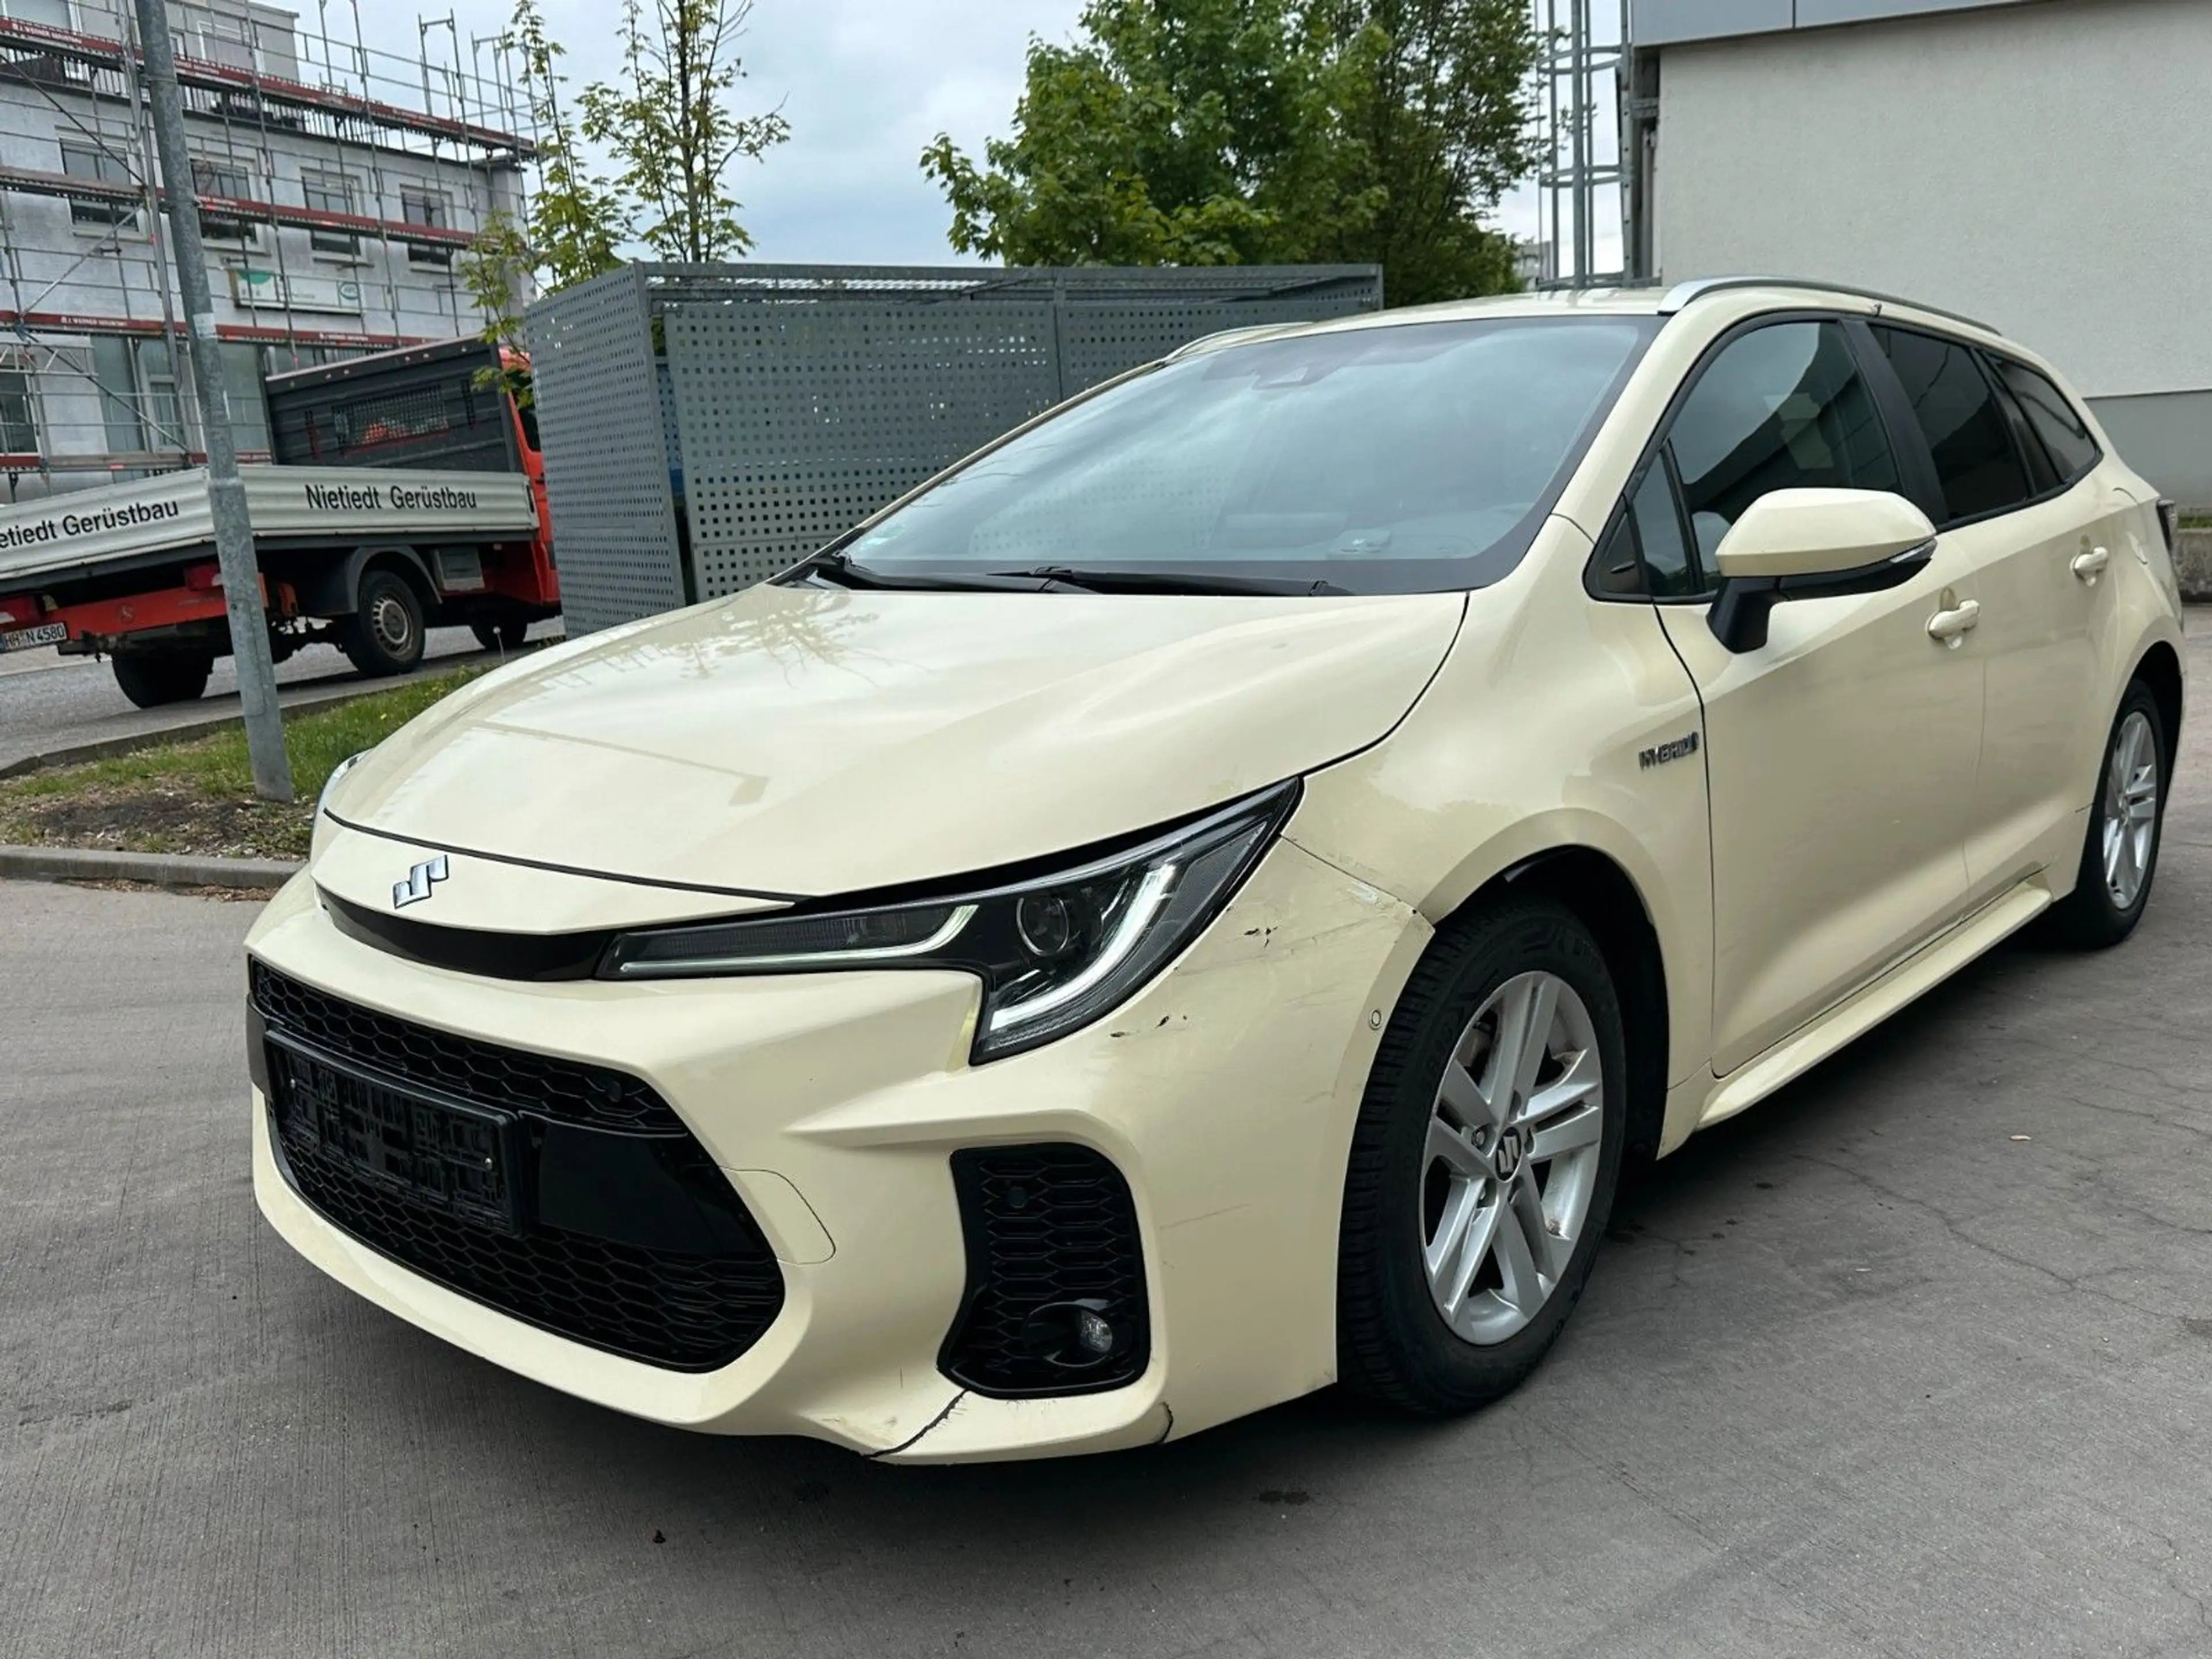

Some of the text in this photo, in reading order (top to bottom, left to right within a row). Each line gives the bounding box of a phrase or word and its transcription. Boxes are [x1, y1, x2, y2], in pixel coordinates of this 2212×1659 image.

[305, 484, 478, 509] Nietiedt Gerüstbau
[63, 501, 179, 536] Gerüstbau
